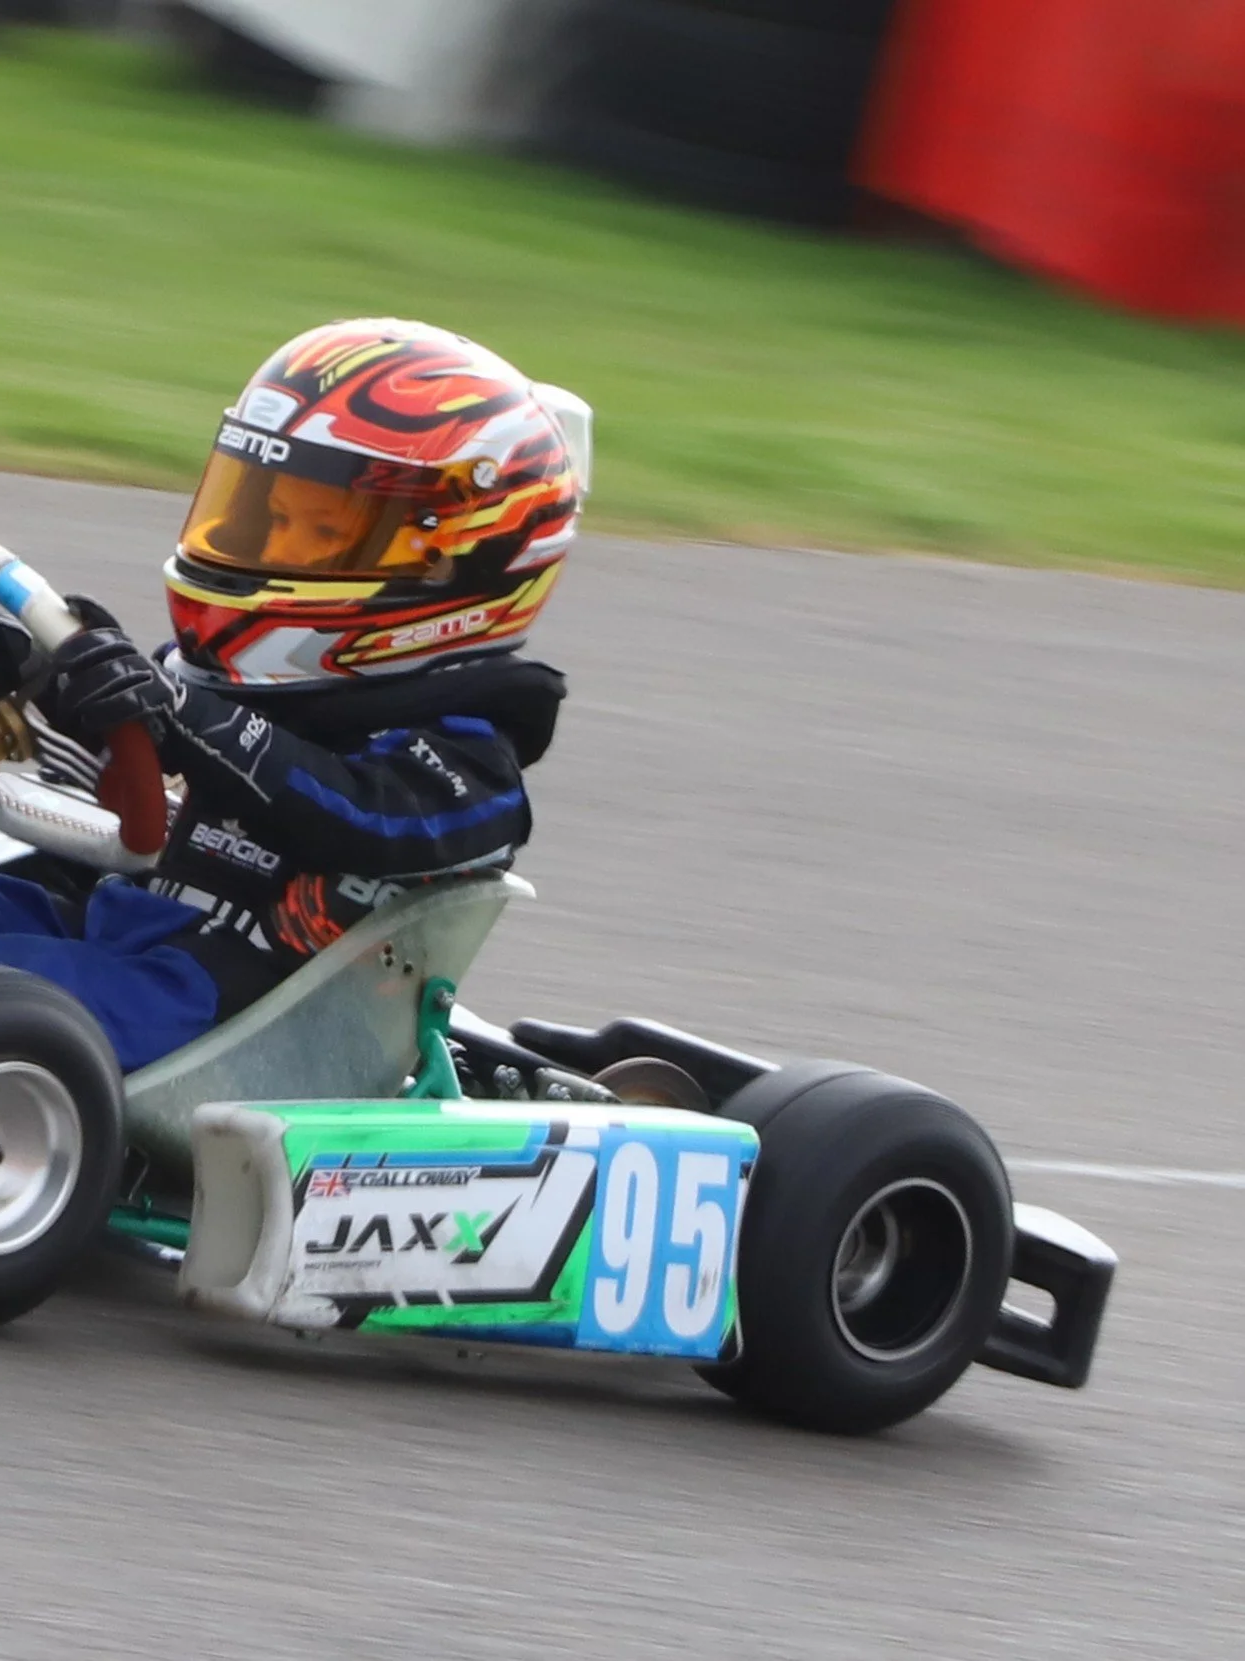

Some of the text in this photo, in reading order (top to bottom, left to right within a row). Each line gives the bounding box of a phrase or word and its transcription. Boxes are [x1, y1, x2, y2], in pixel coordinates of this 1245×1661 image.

[218, 423, 291, 463] zamp
[391, 609, 486, 648] zamp
[305, 1210, 496, 1257] JAXX
[594, 1142, 729, 1337] 95
